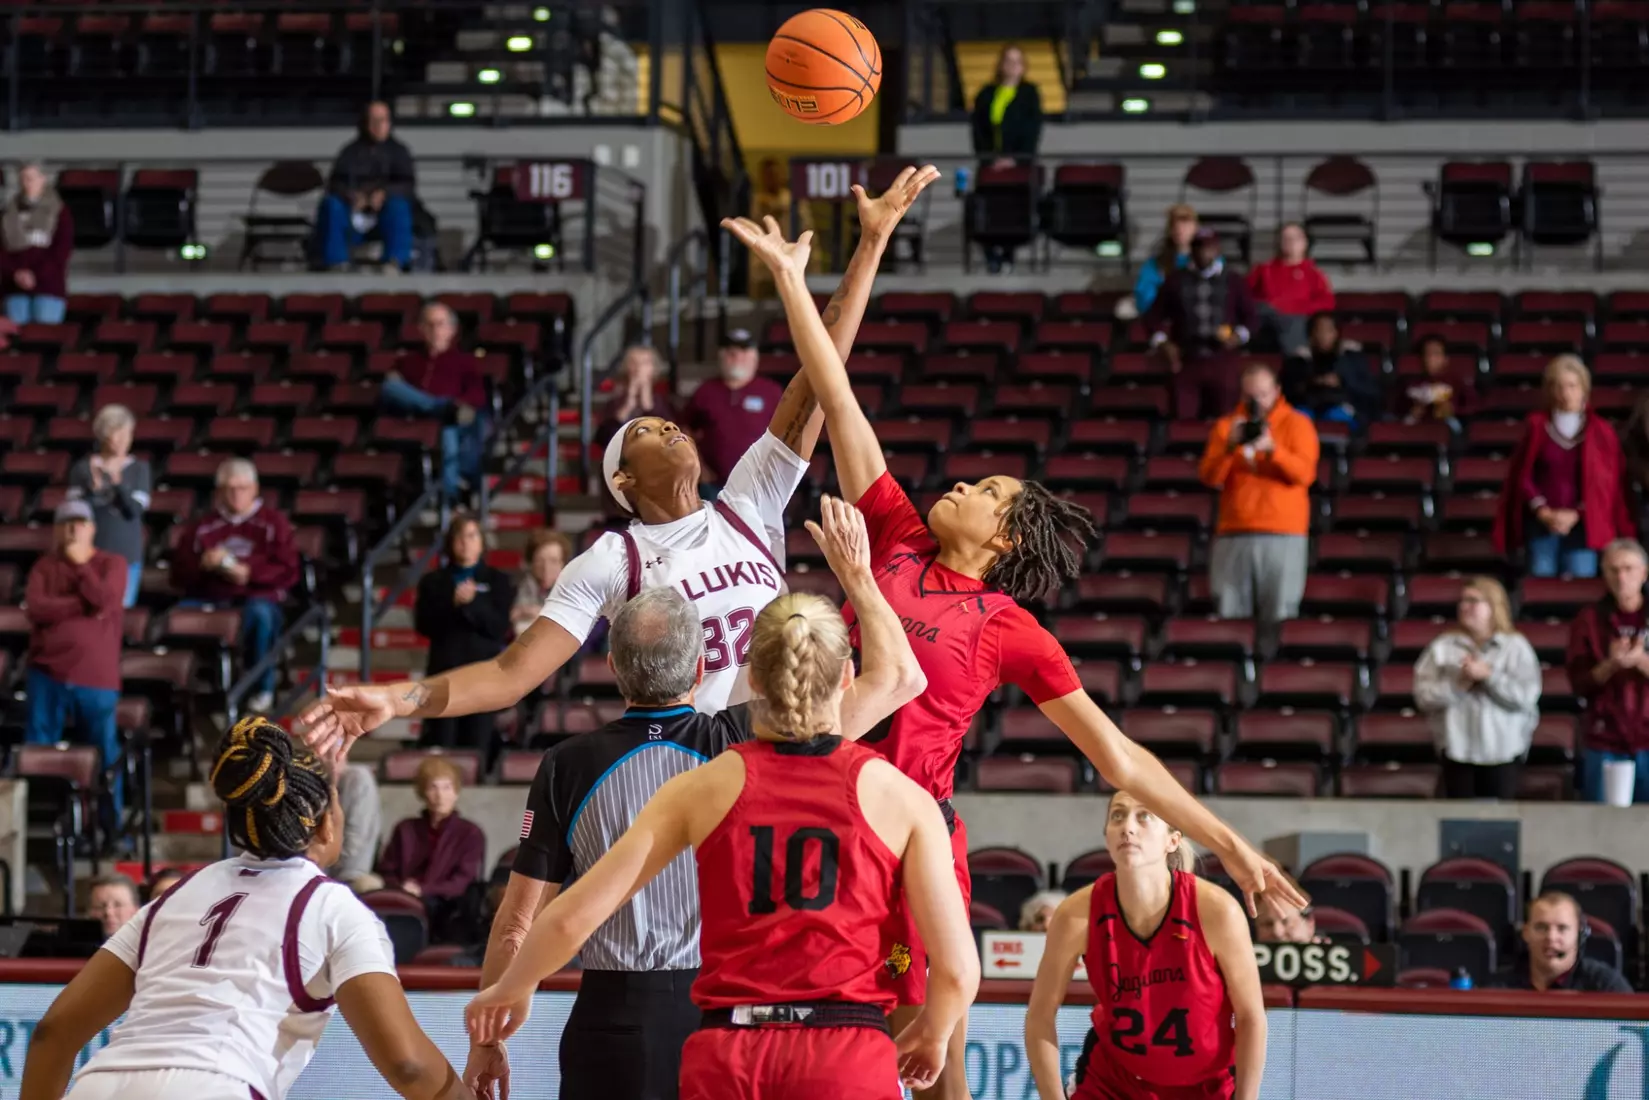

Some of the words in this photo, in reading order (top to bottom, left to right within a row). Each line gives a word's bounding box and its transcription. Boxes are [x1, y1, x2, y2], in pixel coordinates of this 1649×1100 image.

[529, 162, 573, 198] 116
[807, 162, 849, 198] 101
[680, 560, 778, 602] LUKIS
[700, 606, 757, 674] 32
[747, 825, 840, 915] 10
[190, 892, 250, 969] 1
[1109, 962, 1188, 1002] Jaguars
[1252, 944, 1359, 982] POSS.
[1110, 1007, 1195, 1057] 24
